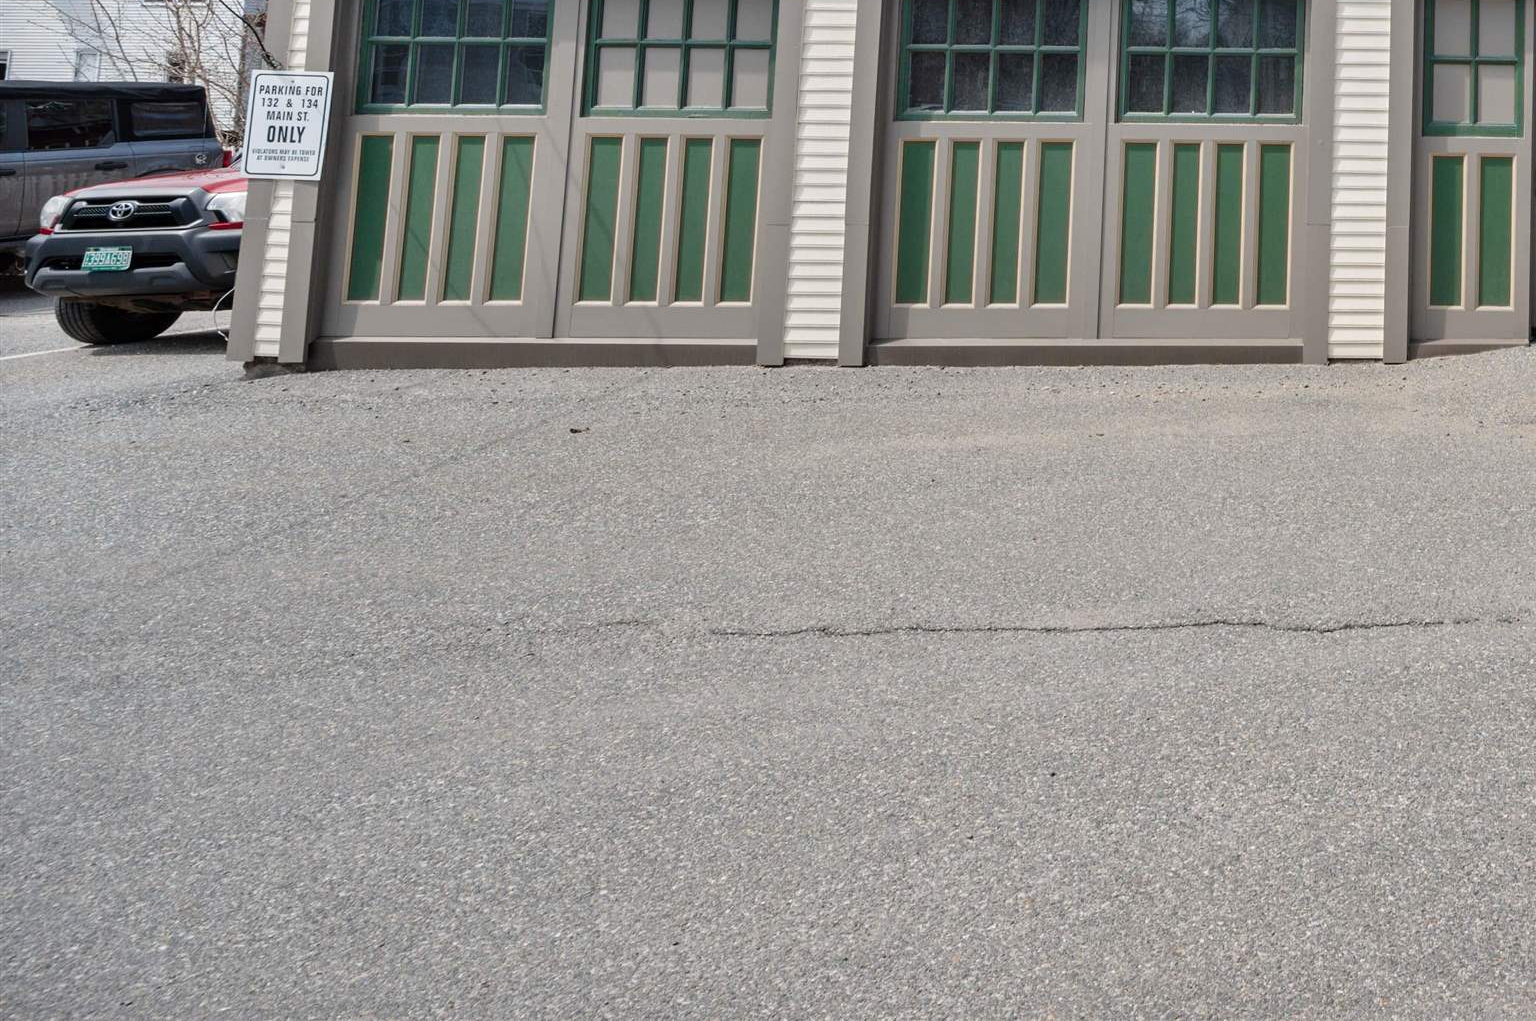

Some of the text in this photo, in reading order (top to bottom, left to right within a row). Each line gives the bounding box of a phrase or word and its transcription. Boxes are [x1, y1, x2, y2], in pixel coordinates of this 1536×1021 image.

[259, 84, 323, 97] PARKING FOR
[261, 97, 318, 109] 132 & 134
[266, 110, 310, 122] MAIN ST.
[267, 125, 306, 143] ONLY
